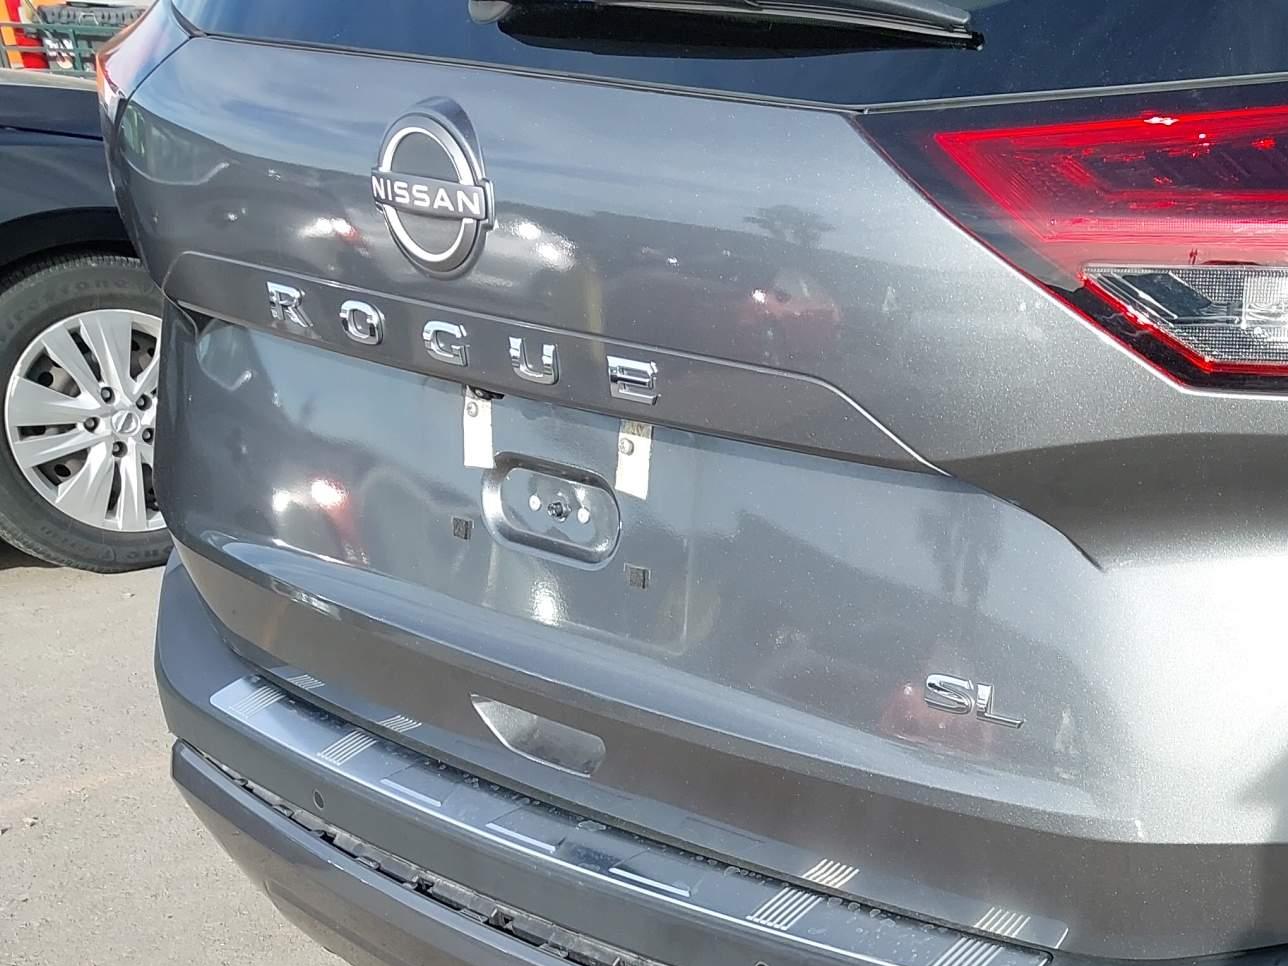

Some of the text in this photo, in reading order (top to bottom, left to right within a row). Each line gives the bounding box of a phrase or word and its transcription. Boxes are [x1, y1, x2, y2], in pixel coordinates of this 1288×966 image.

[371, 175, 481, 215] NISSAN
[266, 281, 660, 406] ROGUE
[925, 674, 1024, 728] SL
